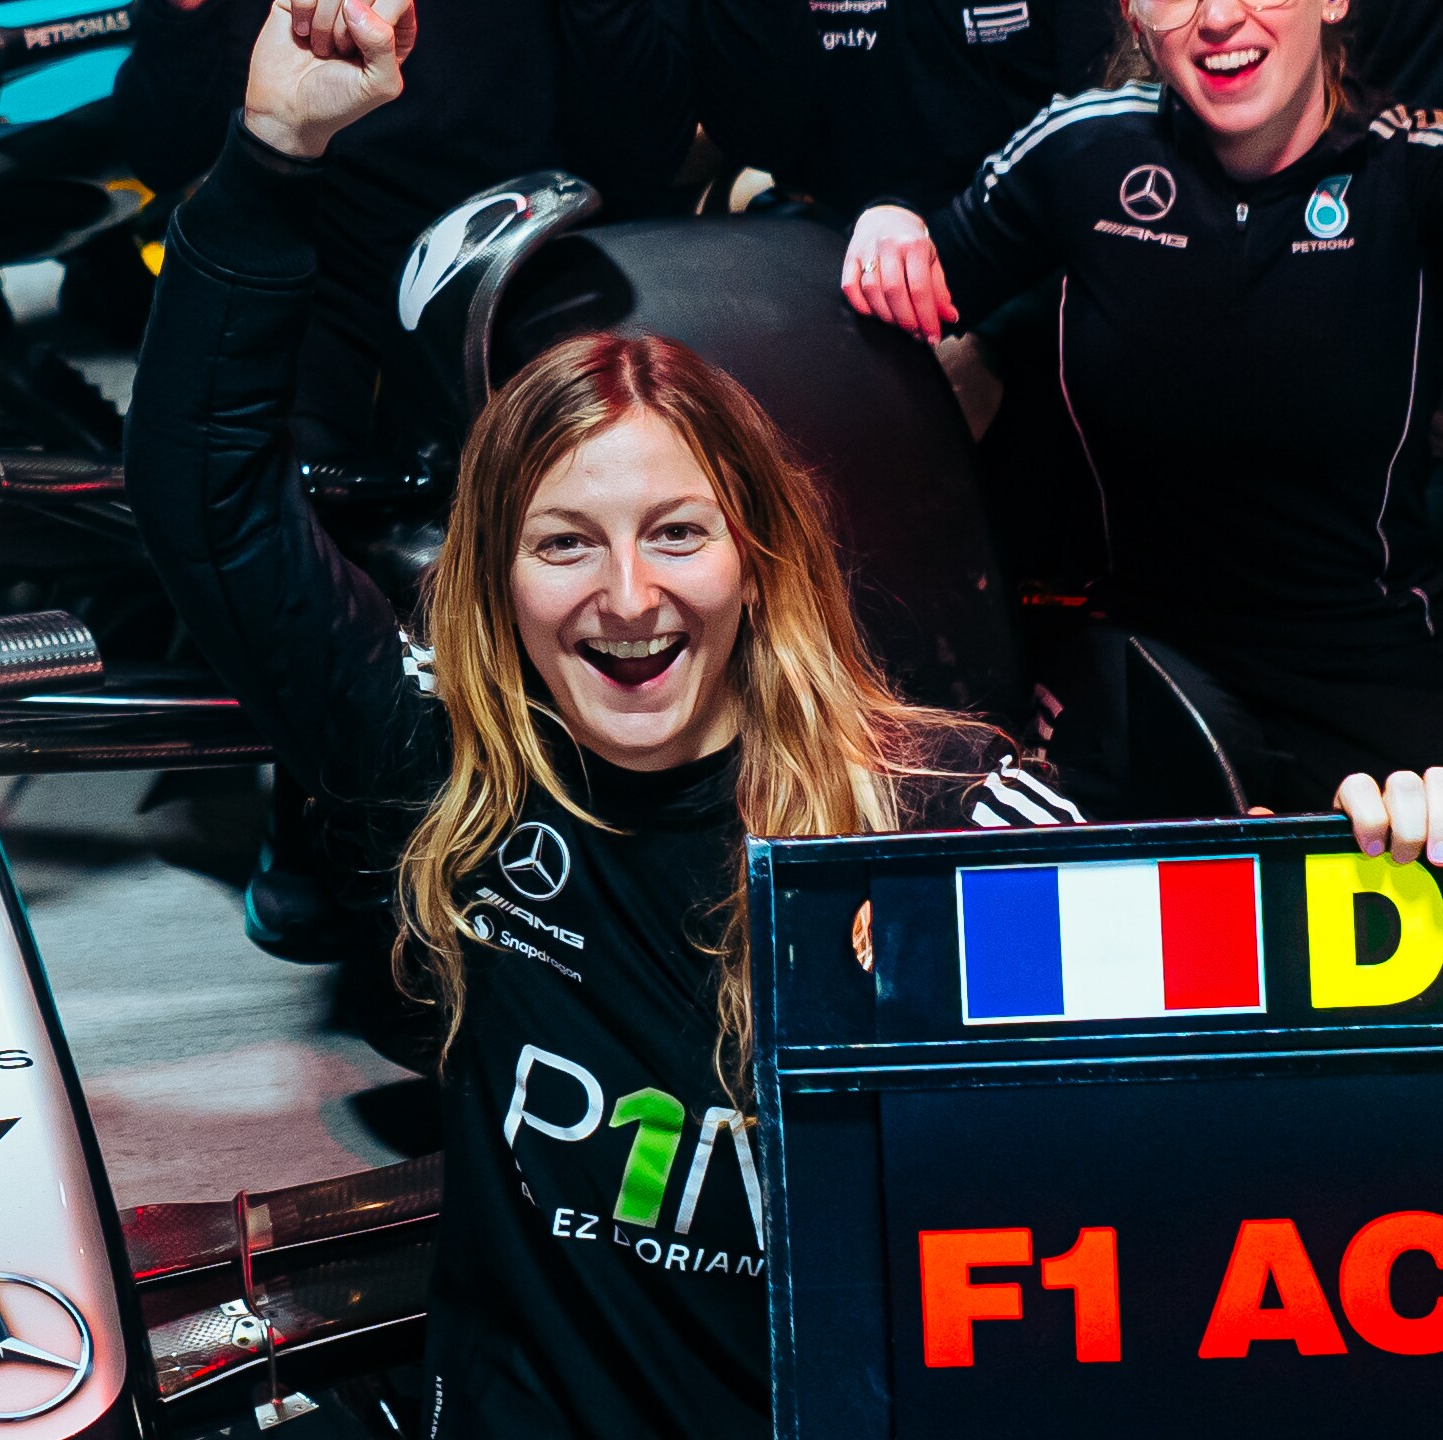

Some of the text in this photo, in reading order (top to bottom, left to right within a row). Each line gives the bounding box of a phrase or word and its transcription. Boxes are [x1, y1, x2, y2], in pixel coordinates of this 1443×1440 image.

[24, 10, 130, 49] PETRONAS
[822, 28, 877, 50] gnify
[1122, 225, 1187, 248] AMG
[1292, 237, 1355, 253] PETRONA
[500, 930, 582, 983] Snapdragon
[919, 1209, 1443, 1369] F1 AC
